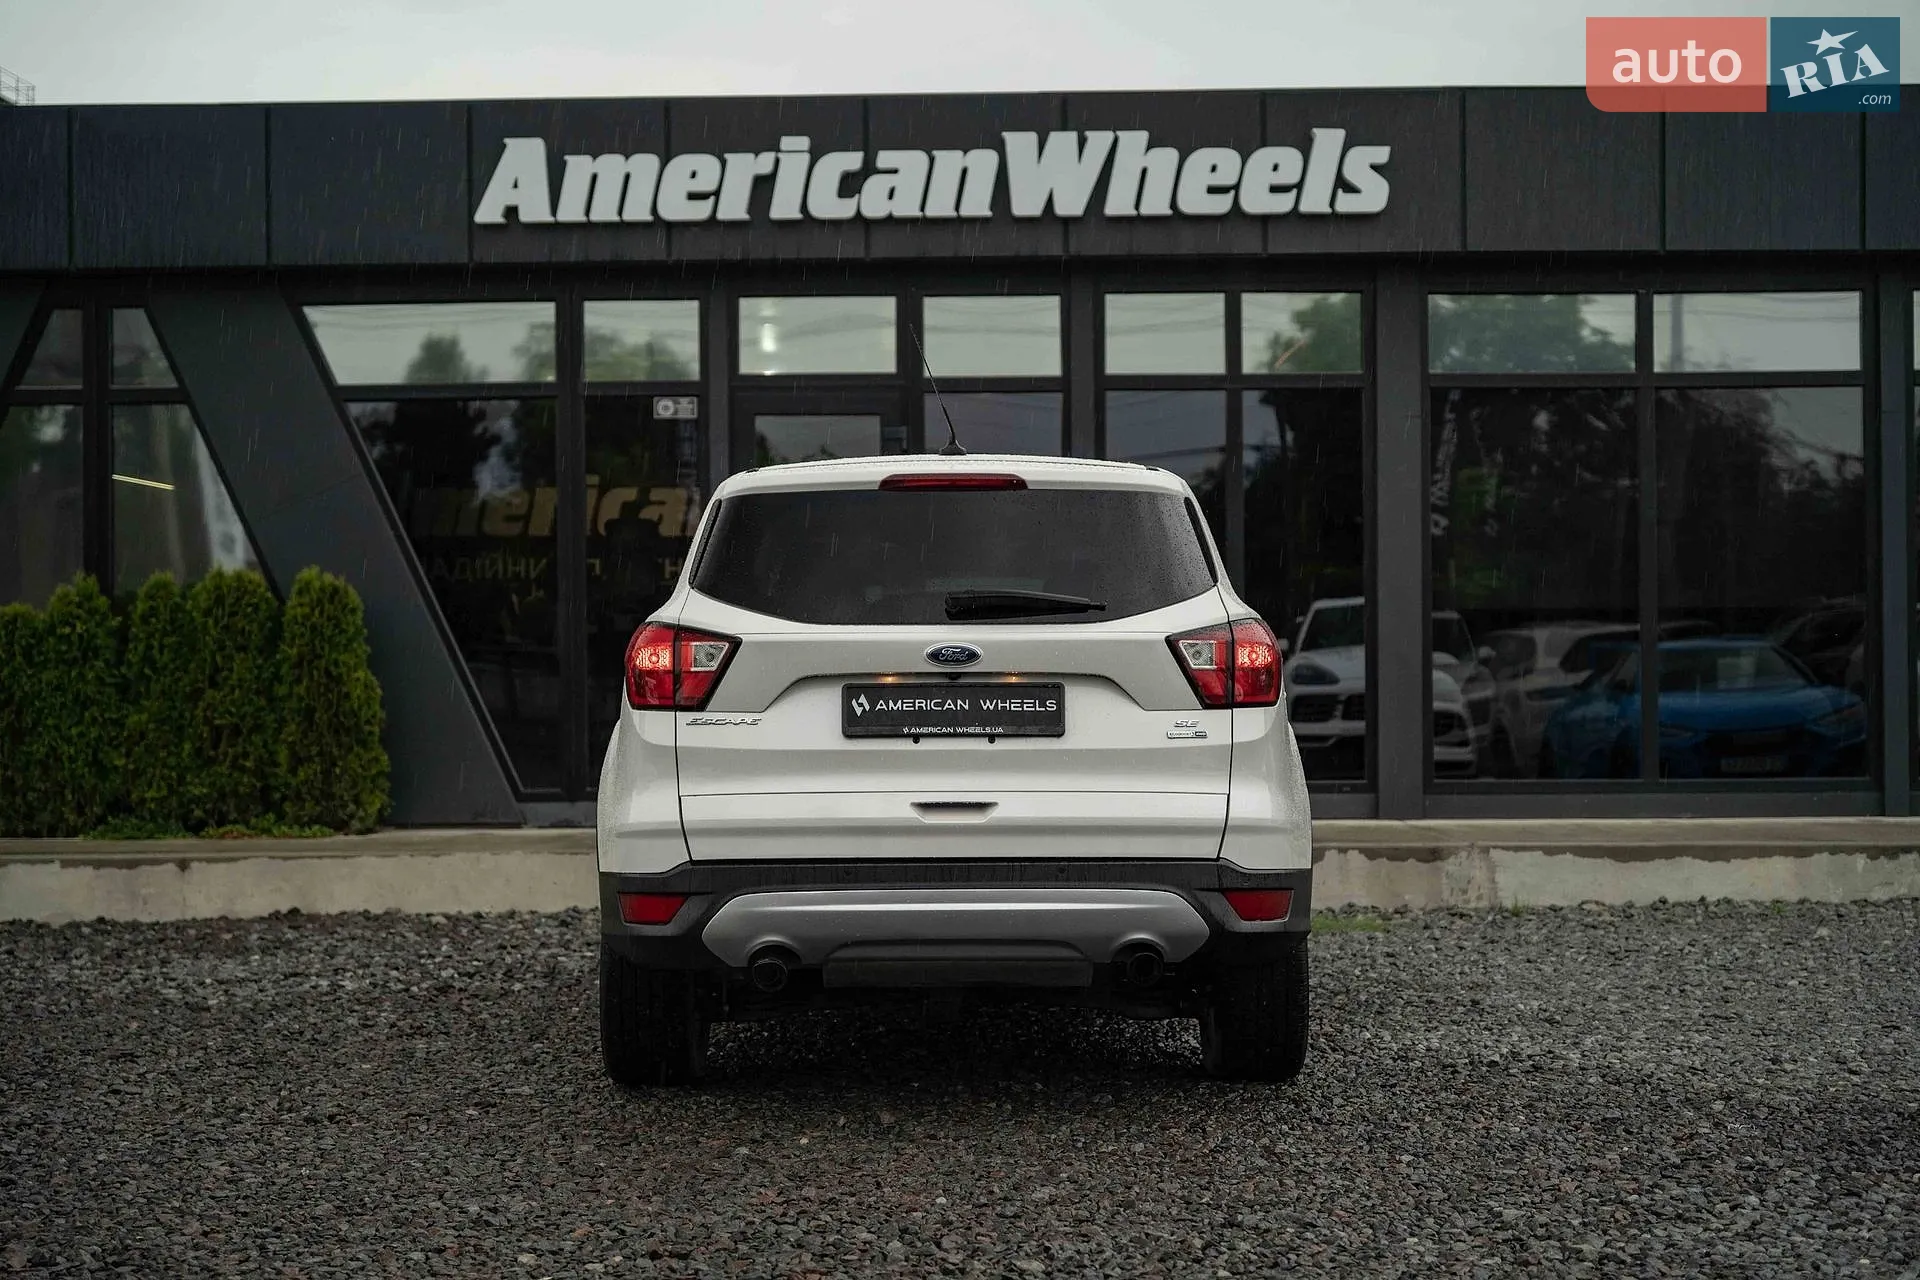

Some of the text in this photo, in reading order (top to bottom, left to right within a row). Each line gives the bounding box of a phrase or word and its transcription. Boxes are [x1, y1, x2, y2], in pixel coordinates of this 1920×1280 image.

[939, 648, 969, 660] Ford
[875, 699, 1057, 711] AMERICAN WHEELS
[686, 717, 762, 726] ESCAPE
[1174, 719, 1200, 728] SE
